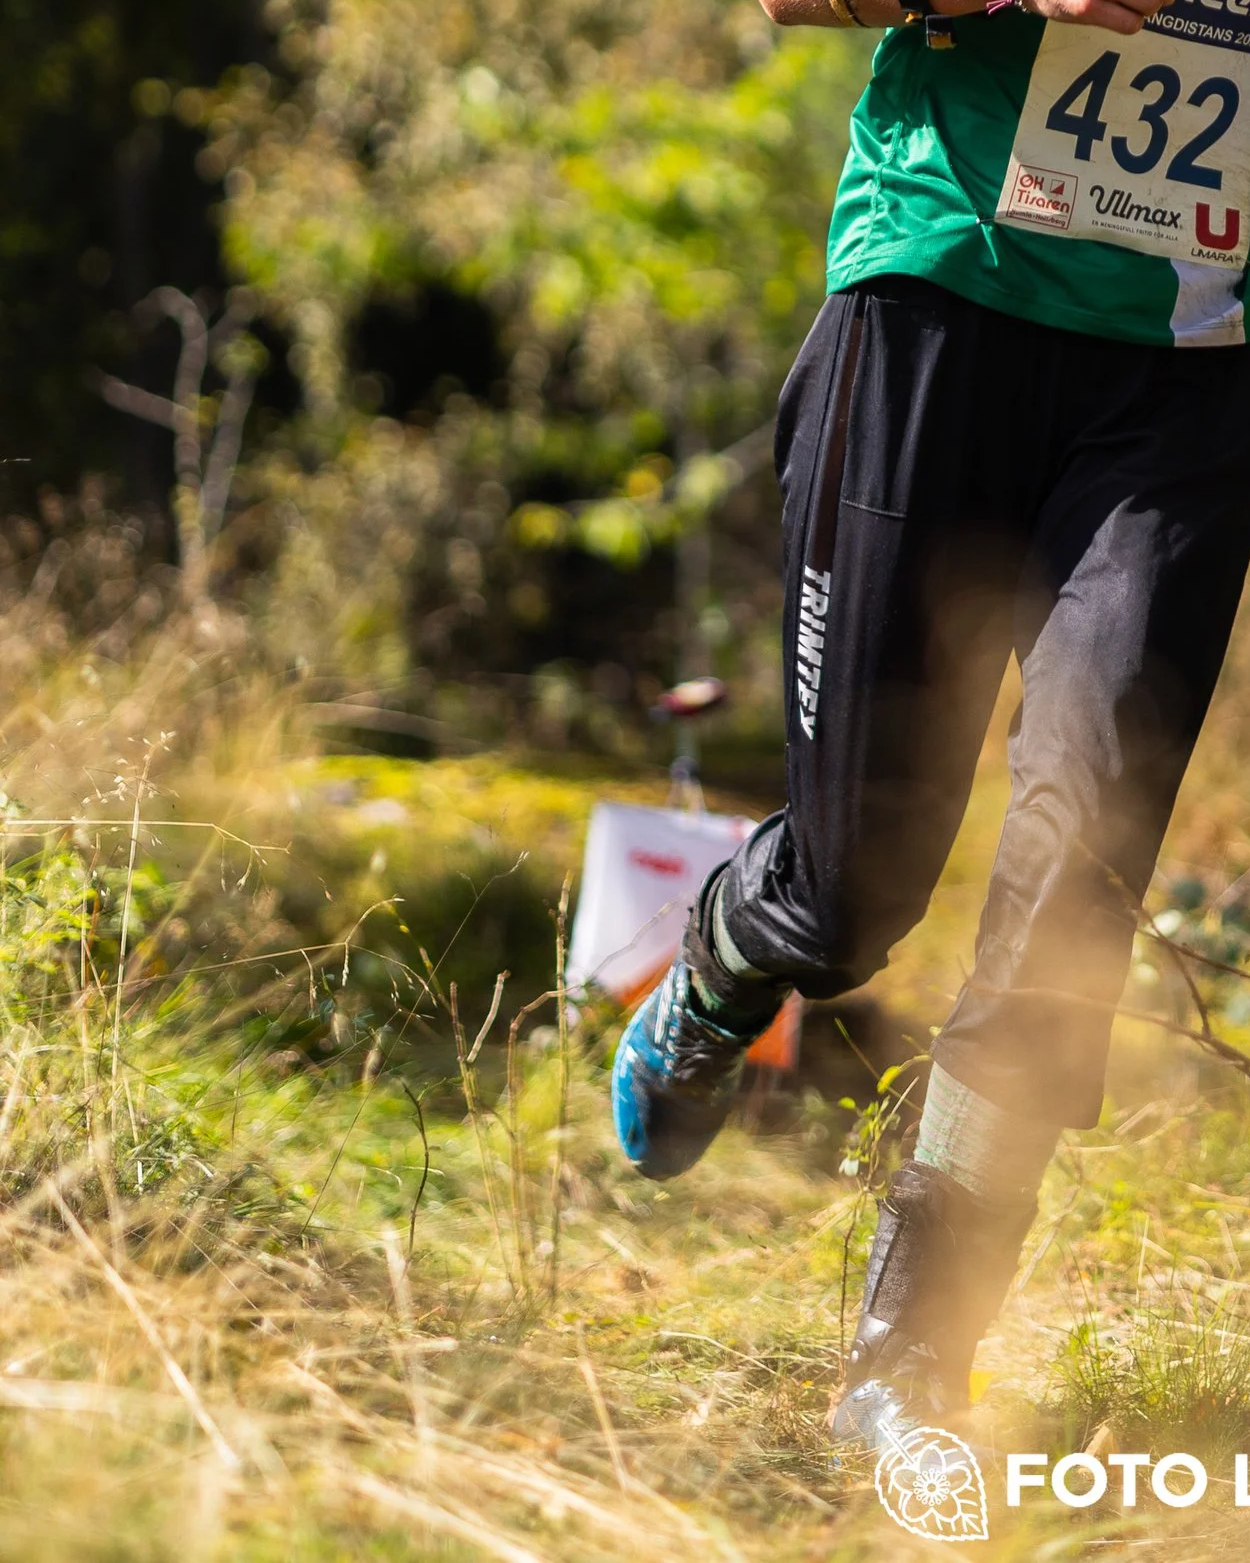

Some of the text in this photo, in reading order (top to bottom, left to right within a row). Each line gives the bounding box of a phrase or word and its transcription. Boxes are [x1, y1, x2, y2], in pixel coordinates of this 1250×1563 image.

[1045, 50, 1240, 191] 432
[1017, 188, 1071, 214] Tisaren
[1089, 184, 1182, 229] Ullmax
[1195, 201, 1240, 251] U
[1190, 247, 1235, 264] UMARA
[797, 564, 832, 741] TRIMTEX
